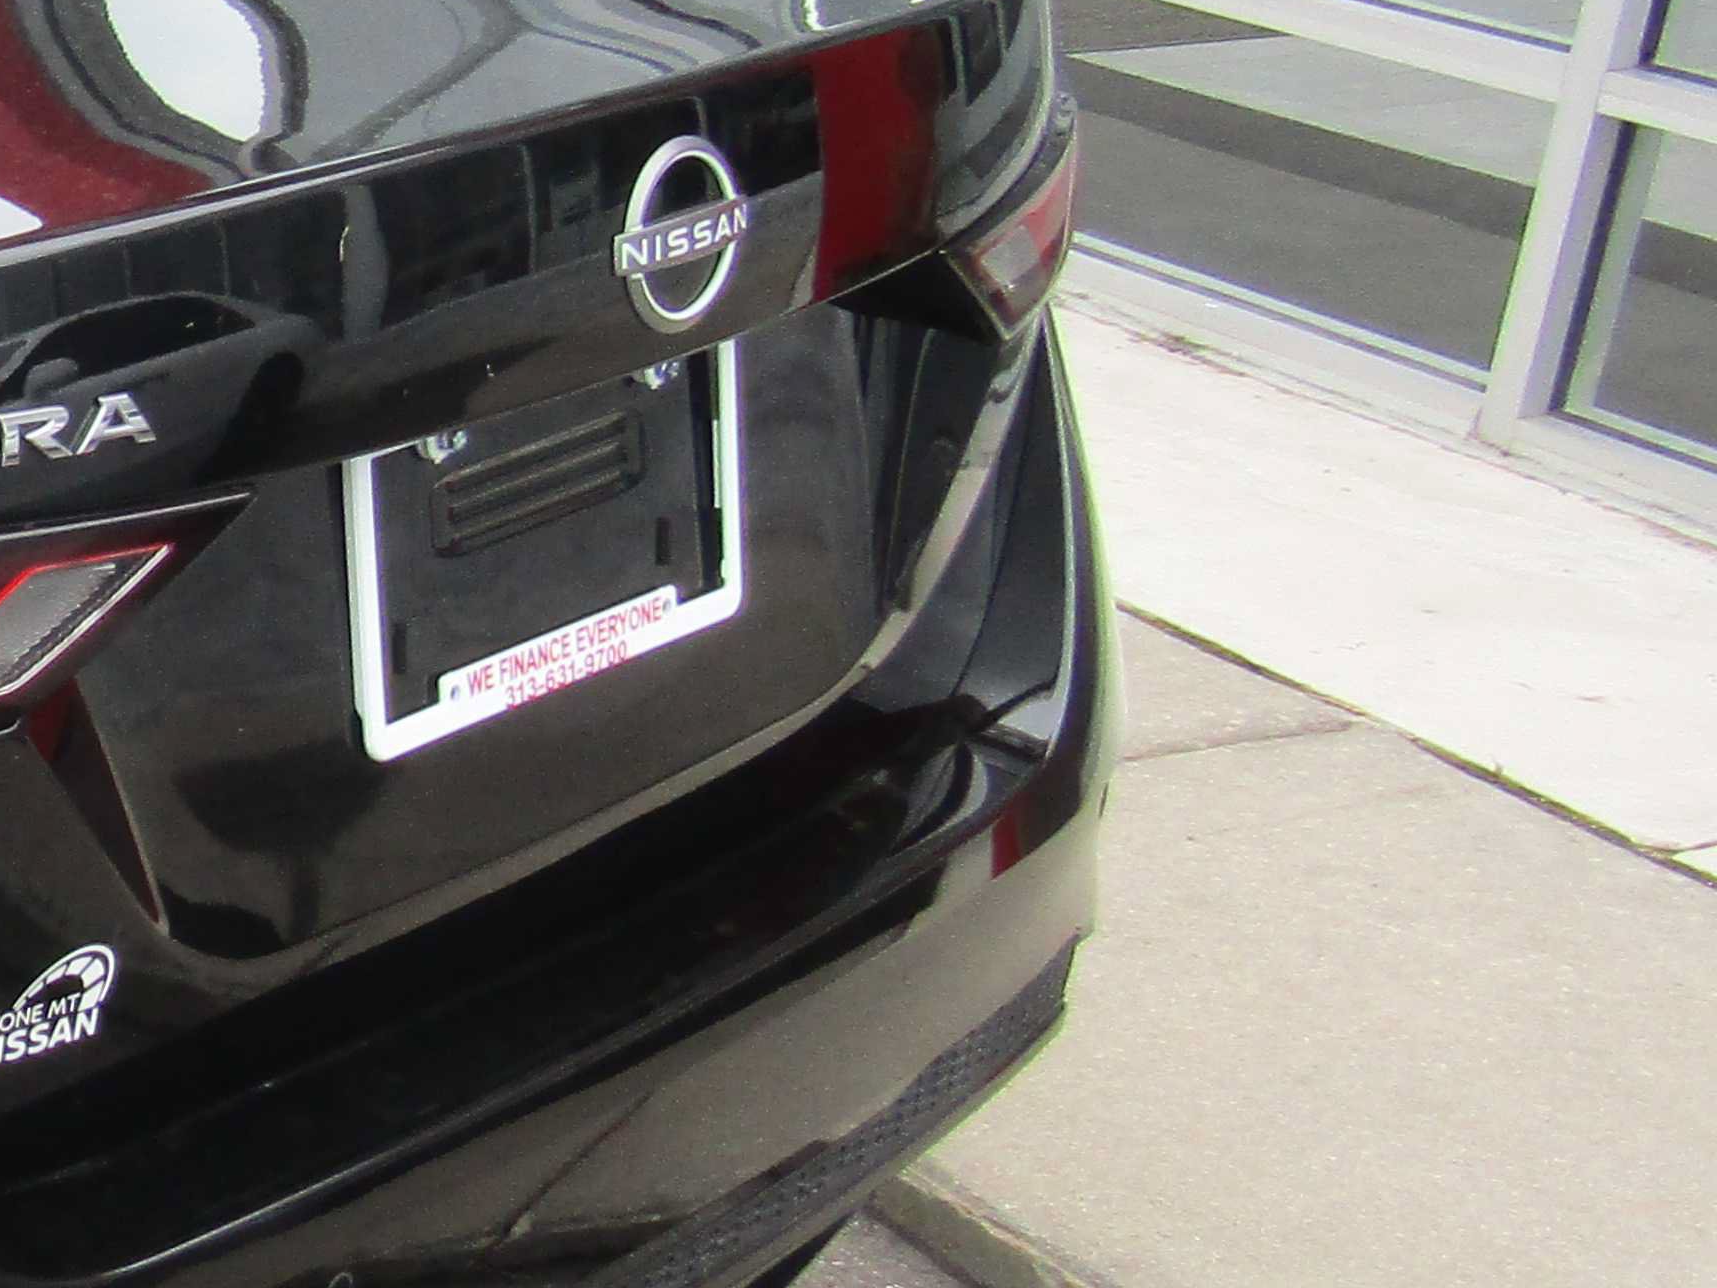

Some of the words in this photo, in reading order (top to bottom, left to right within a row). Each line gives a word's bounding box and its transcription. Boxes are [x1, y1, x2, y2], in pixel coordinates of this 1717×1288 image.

[620, 202, 748, 271] NISSAN
[466, 669, 494, 696] WE
[499, 633, 572, 684] FINANCE
[576, 595, 665, 653] EVERYONE
[505, 639, 628, 709] 313-631-9700
[47, 992, 82, 1016] MT
